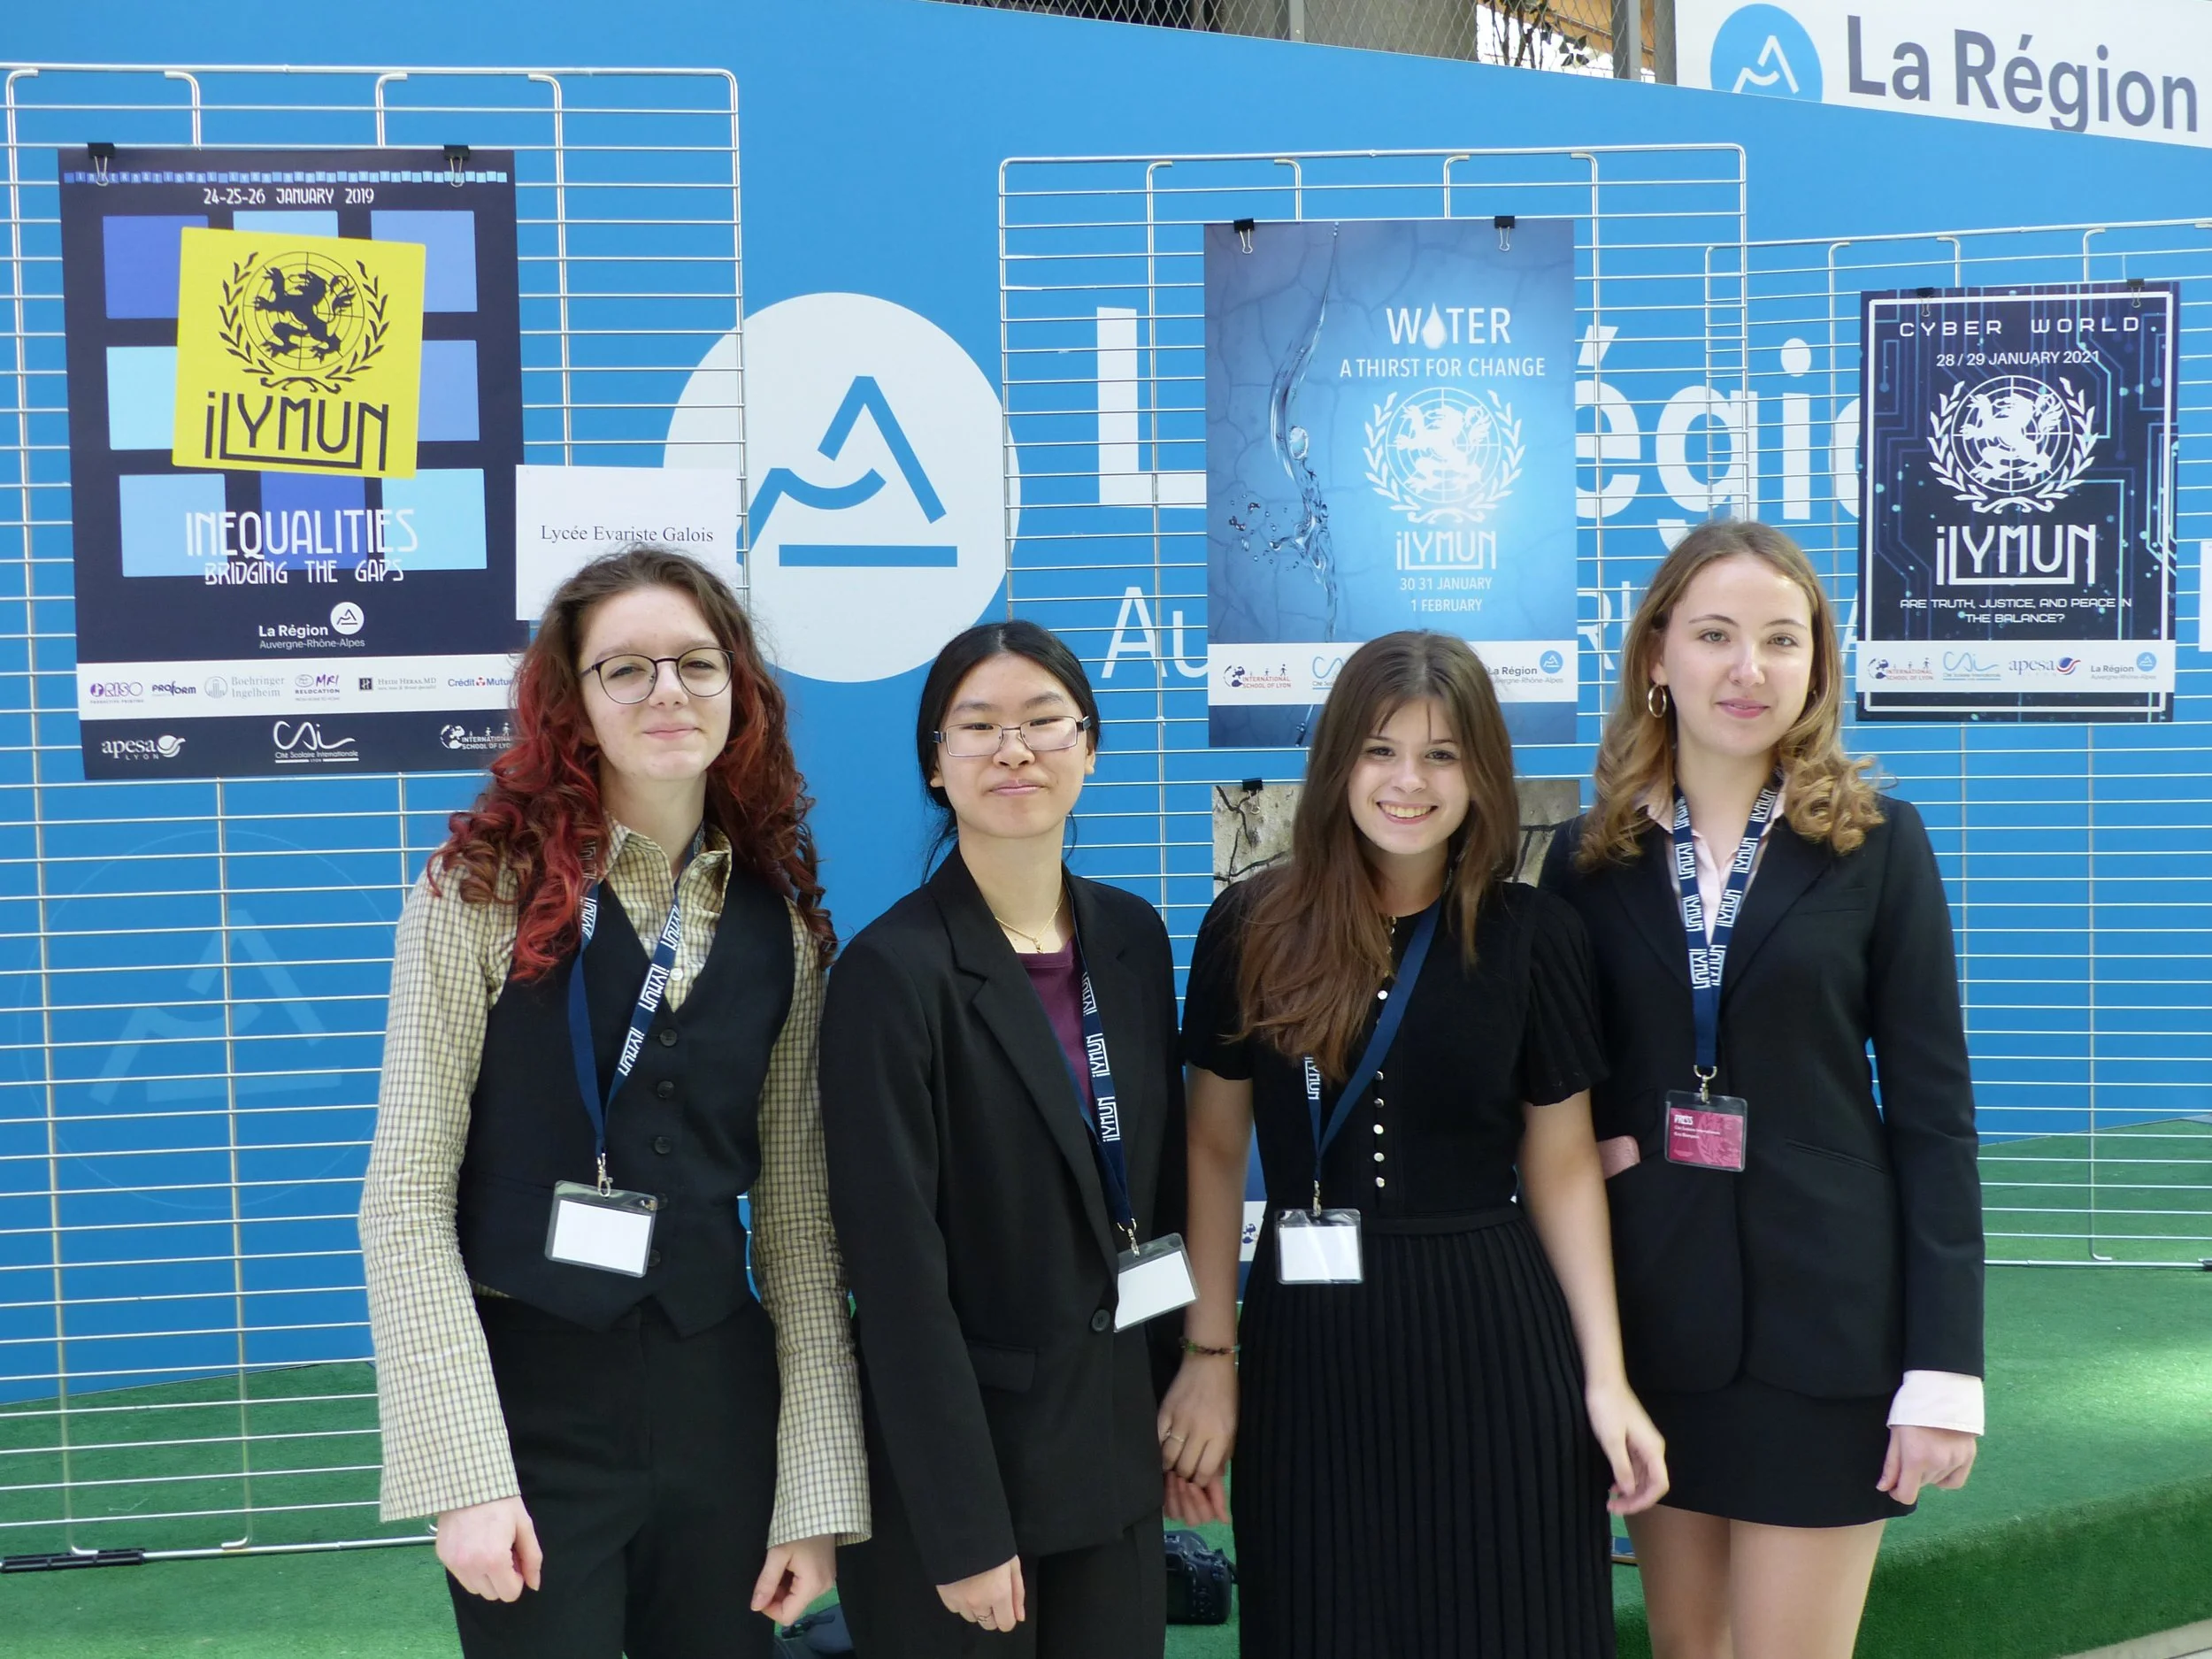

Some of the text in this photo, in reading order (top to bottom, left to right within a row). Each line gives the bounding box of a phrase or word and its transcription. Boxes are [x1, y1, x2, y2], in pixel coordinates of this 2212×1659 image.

[1847, 14, 2199, 134] La Région
[204, 188, 374, 205] 24-25-26 JANUARY 2019
[1900, 316, 2139, 337] CYBER WORLD
[1936, 354, 1955, 367] 28
[1968, 353, 1985, 366] 29
[1988, 351, 2060, 365] JANUARY
[2063, 350, 2100, 364] 2021
[1340, 357, 1546, 378] A THIRST FOR CHANGE
[1096, 306, 1207, 510] L
[185, 509, 419, 559] INEQUALITIES
[541, 525, 713, 543] Lycée Evariste Galois
[204, 559, 404, 585] BRIDGING THE GAPS
[1400, 576, 1493, 591] 30 31 JANUARY
[1410, 598, 1482, 612] 1 FEBRUARY
[1900, 599, 1927, 609] ARE
[1932, 598, 1976, 610] TRUTH,
[1979, 598, 2036, 610] JUSTICE,
[2039, 598, 2068, 609] AND
[2070, 597, 2116, 608] PEACE
[1965, 612, 2065, 624] THE BALANCE?
[258, 624, 328, 639] La Région
[259, 638, 365, 650] Auvergne-Rhône-Alpes
[1502, 665, 1538, 677] Région
[2008, 657, 2055, 675] apesa
[2103, 664, 2134, 674] Région
[231, 676, 285, 687] Boehringer
[231, 687, 280, 699] Ingelheim
[102, 740, 157, 759] apesa
